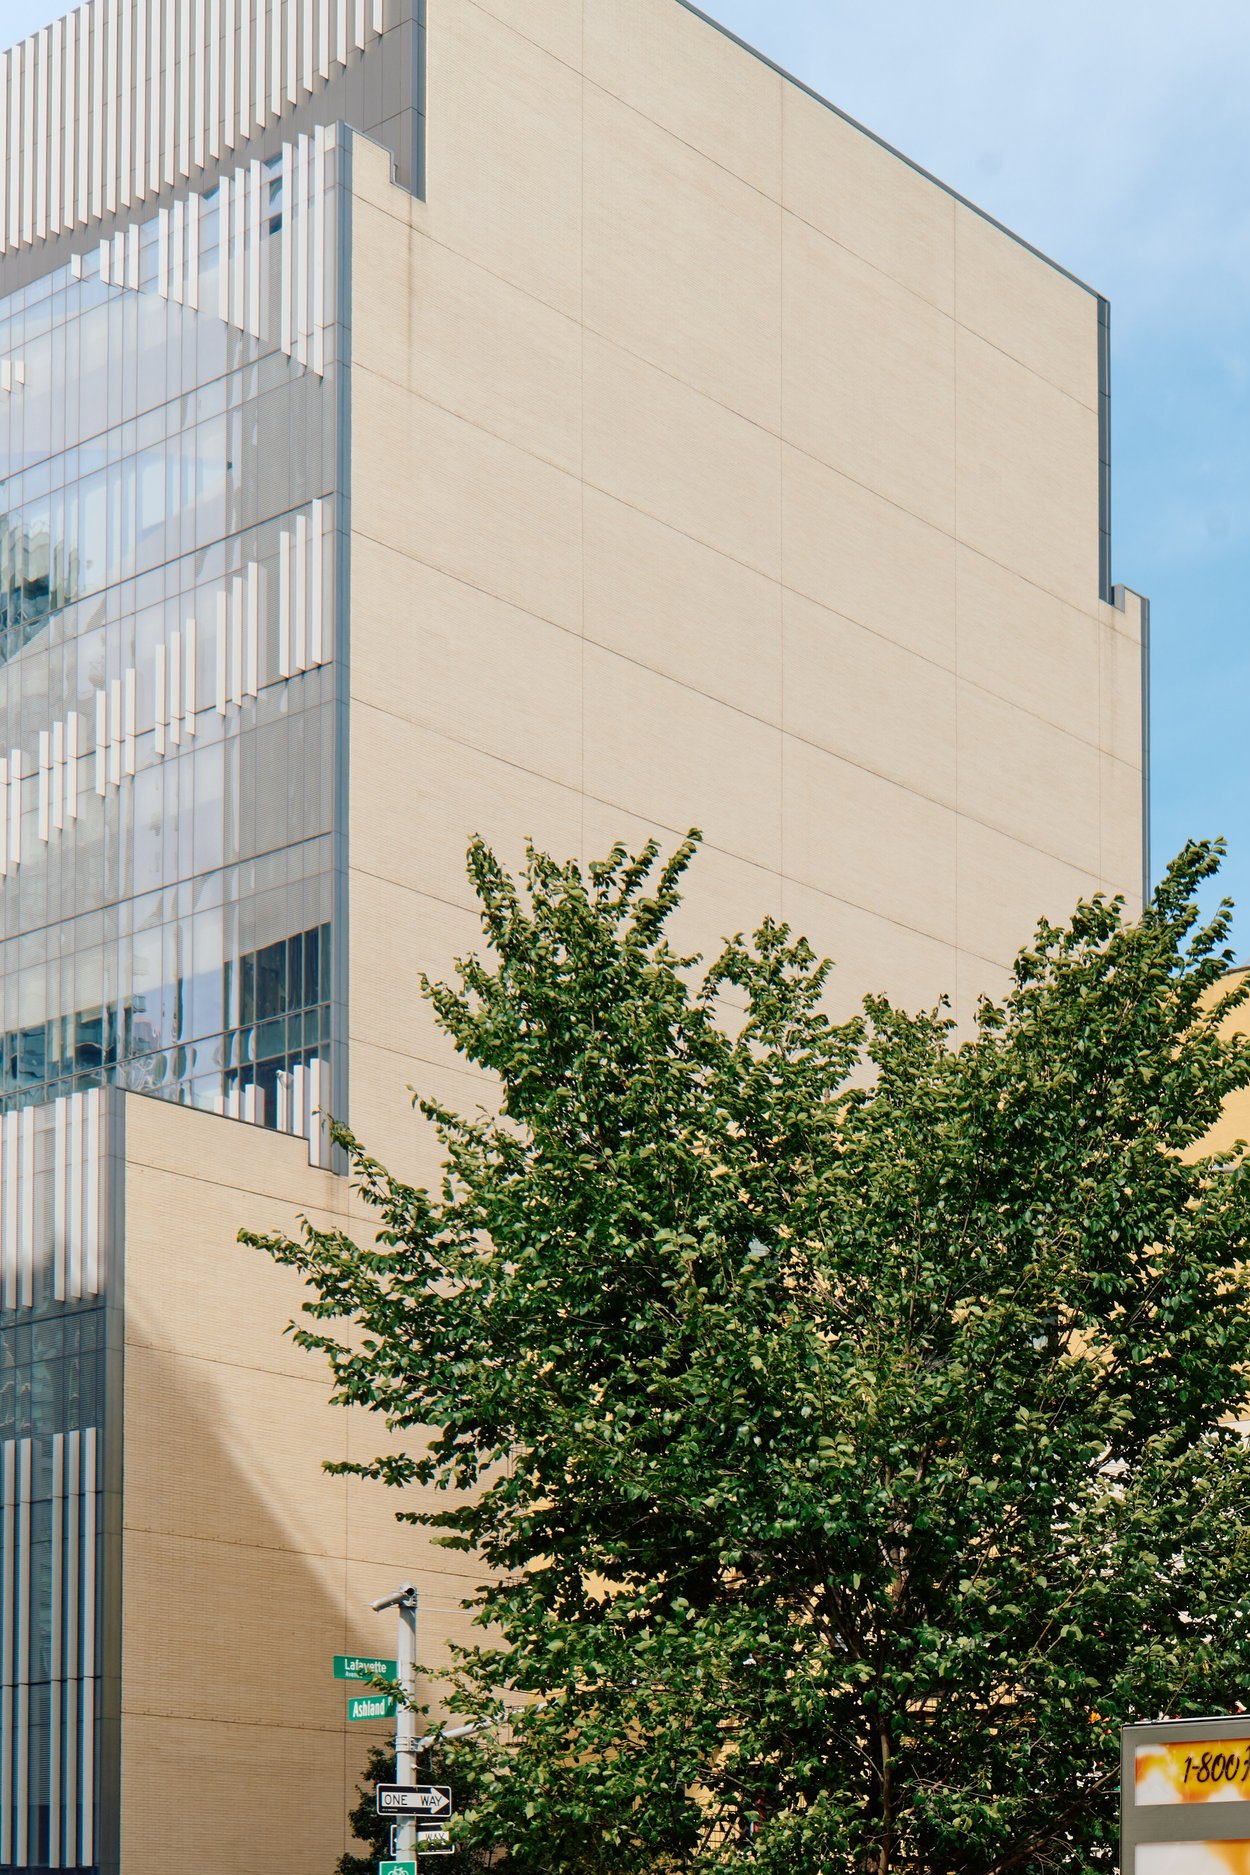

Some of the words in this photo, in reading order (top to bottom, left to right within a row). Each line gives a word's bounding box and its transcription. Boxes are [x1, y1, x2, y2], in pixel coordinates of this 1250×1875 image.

[344, 1658, 387, 1673] Lafayette
[352, 1698, 386, 1718] Ashland
[1184, 1752, 1240, 1784] 1-800
[384, 1794, 408, 1806] ONE
[420, 1795, 442, 1807] WAY
